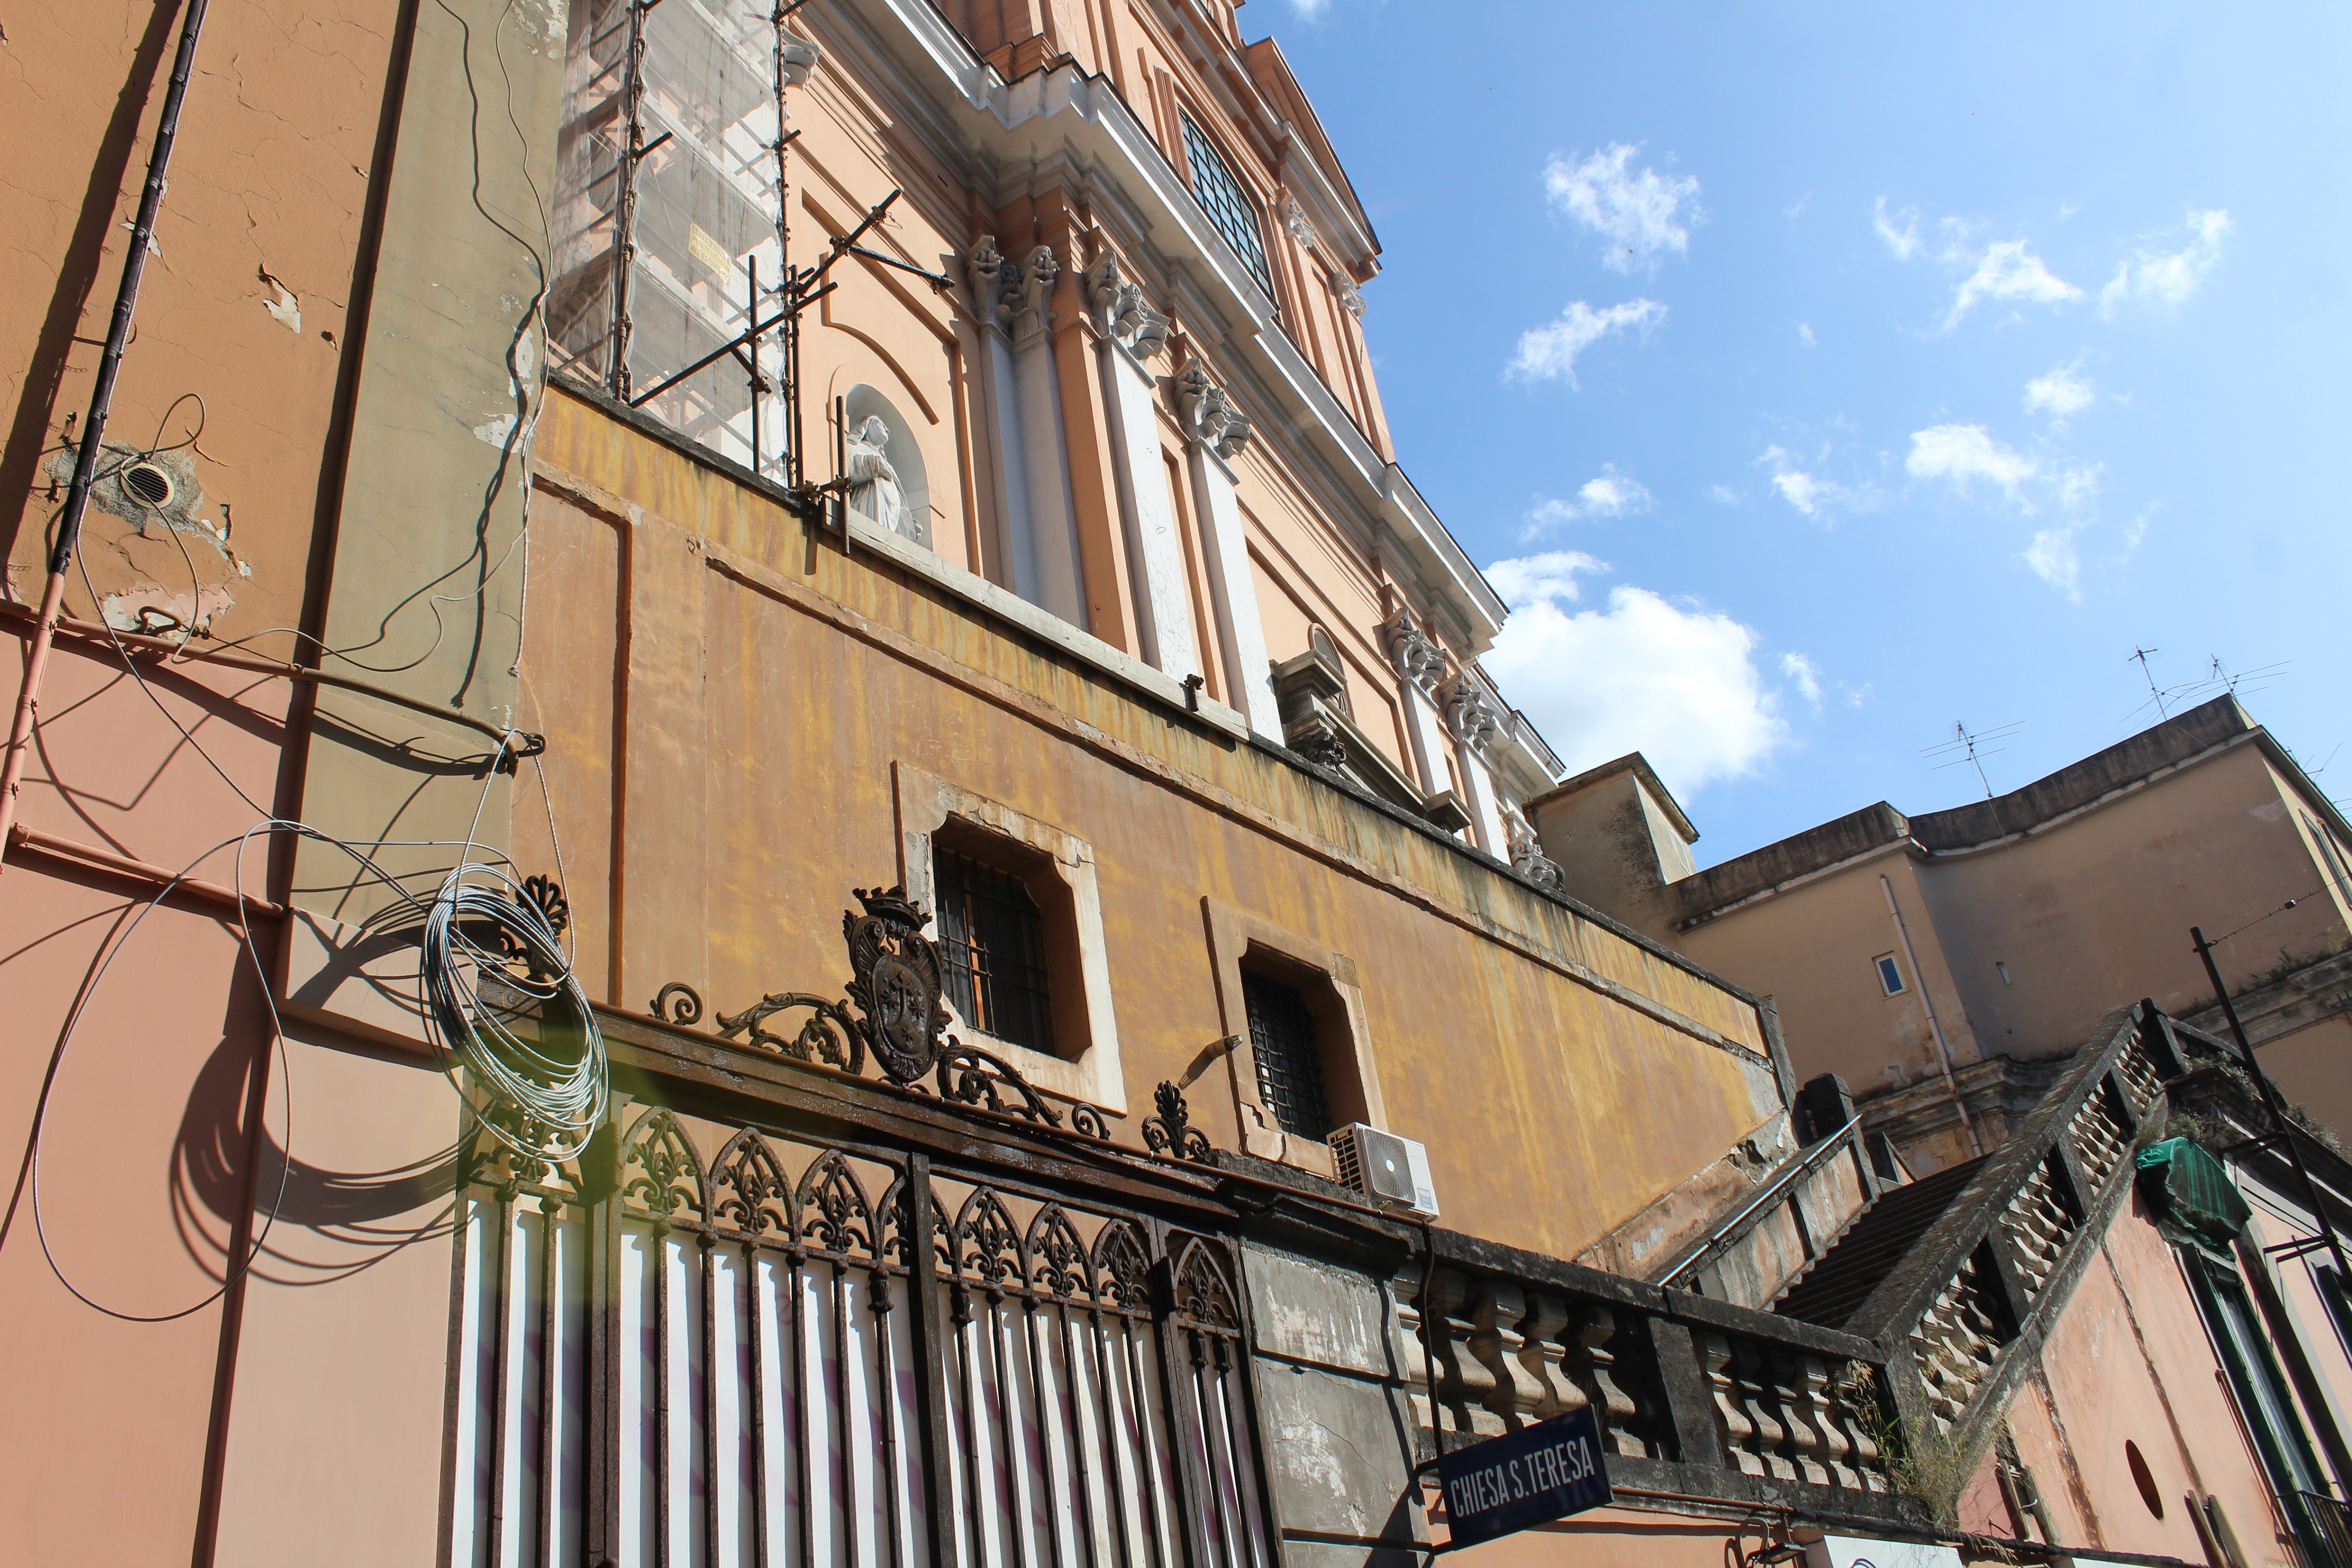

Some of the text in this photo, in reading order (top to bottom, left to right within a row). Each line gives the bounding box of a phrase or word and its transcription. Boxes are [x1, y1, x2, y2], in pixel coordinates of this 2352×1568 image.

[691, 244, 730, 284] ALLESTIME
[1450, 1436, 1595, 1517] CHIESA S. TERESA
